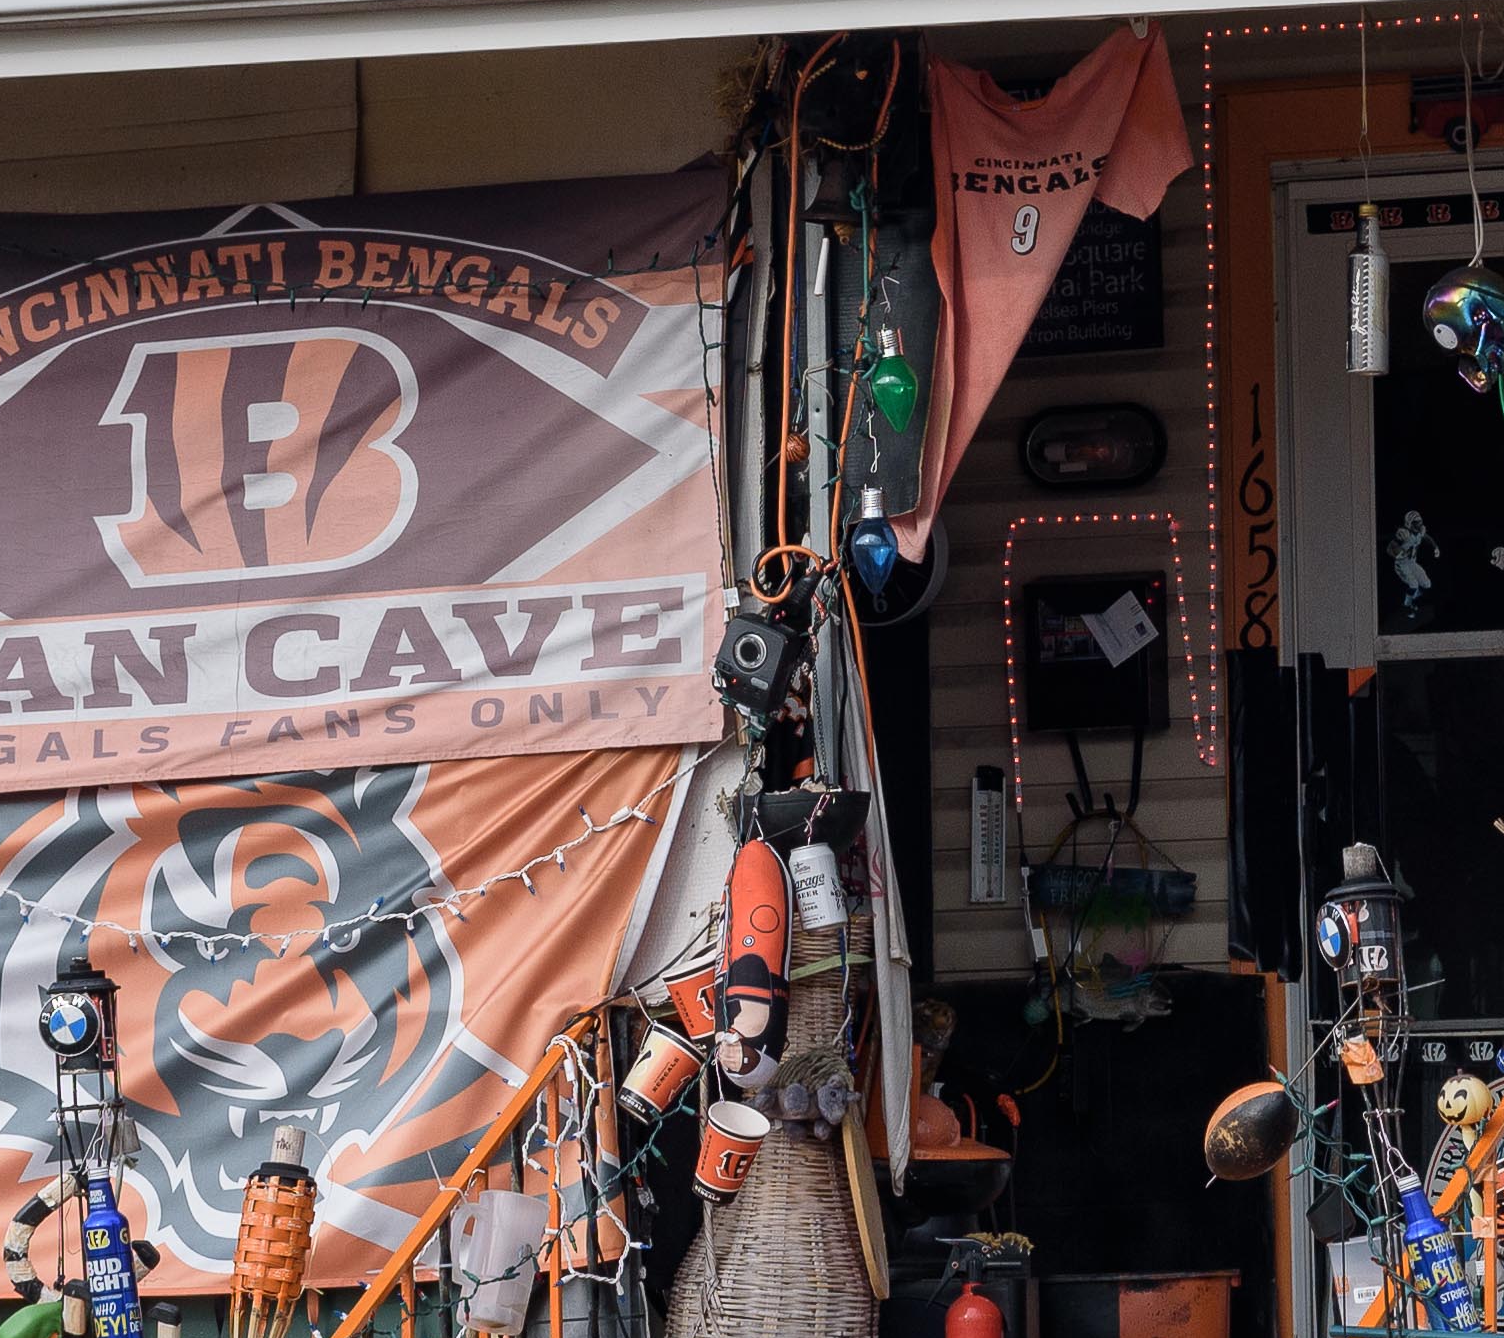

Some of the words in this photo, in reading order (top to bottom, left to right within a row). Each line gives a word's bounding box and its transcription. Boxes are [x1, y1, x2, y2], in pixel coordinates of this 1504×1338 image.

[975, 152, 1082, 170] CINCINNATI
[1011, 204, 1040, 255] 9
[1090, 265, 1145, 295] Park
[316, 240, 622, 351] BENGALS
[1066, 322, 1134, 342] Building
[1239, 382, 1278, 650] 1658
[244, 586, 685, 698] CAVE
[220, 703, 417, 747] FANS
[471, 685, 669, 728] ONLY
[40, 994, 86, 1023] BMW
[87, 1257, 123, 1276] BUD
[89, 1272, 131, 1294] IGHT
[1439, 1285, 1470, 1305] STRIPES
[95, 1302, 117, 1317] WHO
